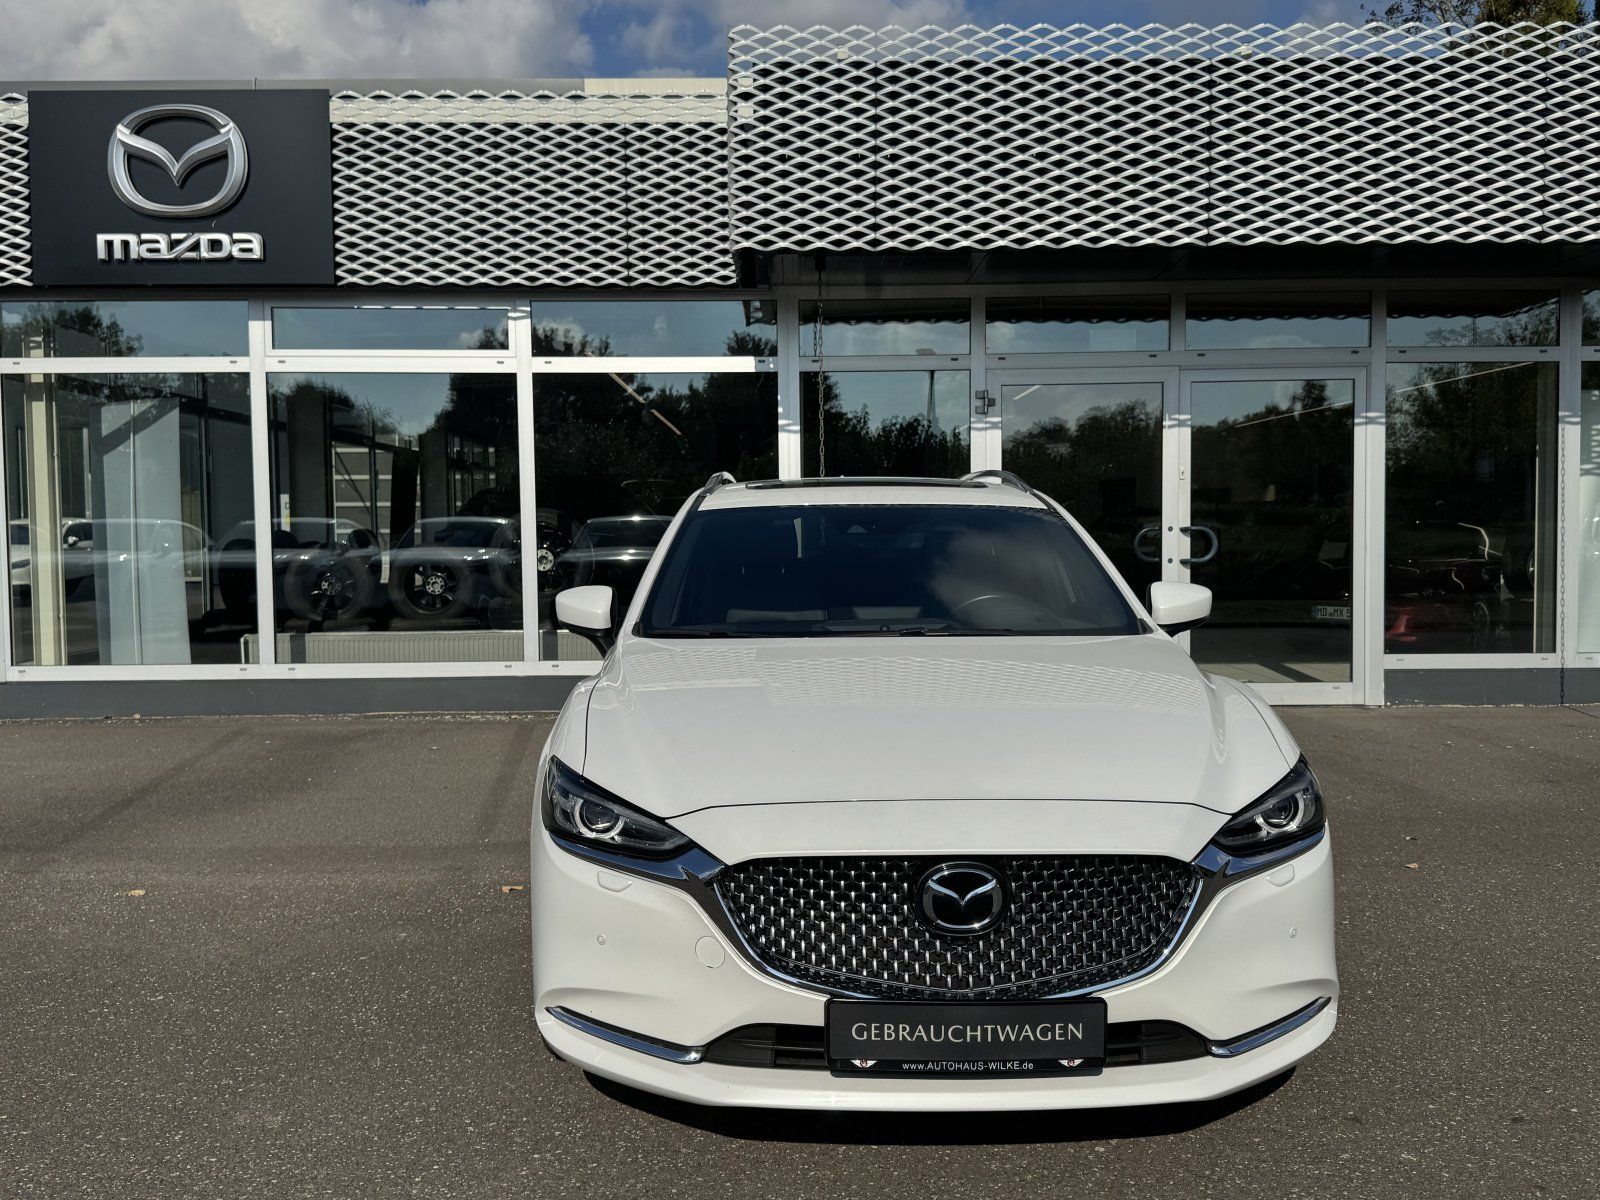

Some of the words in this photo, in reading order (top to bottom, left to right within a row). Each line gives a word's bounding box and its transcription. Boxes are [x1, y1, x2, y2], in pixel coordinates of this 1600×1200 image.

[96, 233, 264, 261] mazda
[851, 1022, 1084, 1043] GEBRAUCHTWAGEN
[902, 1060, 1034, 1071] www.AUTOHAUS-WILKE.de
